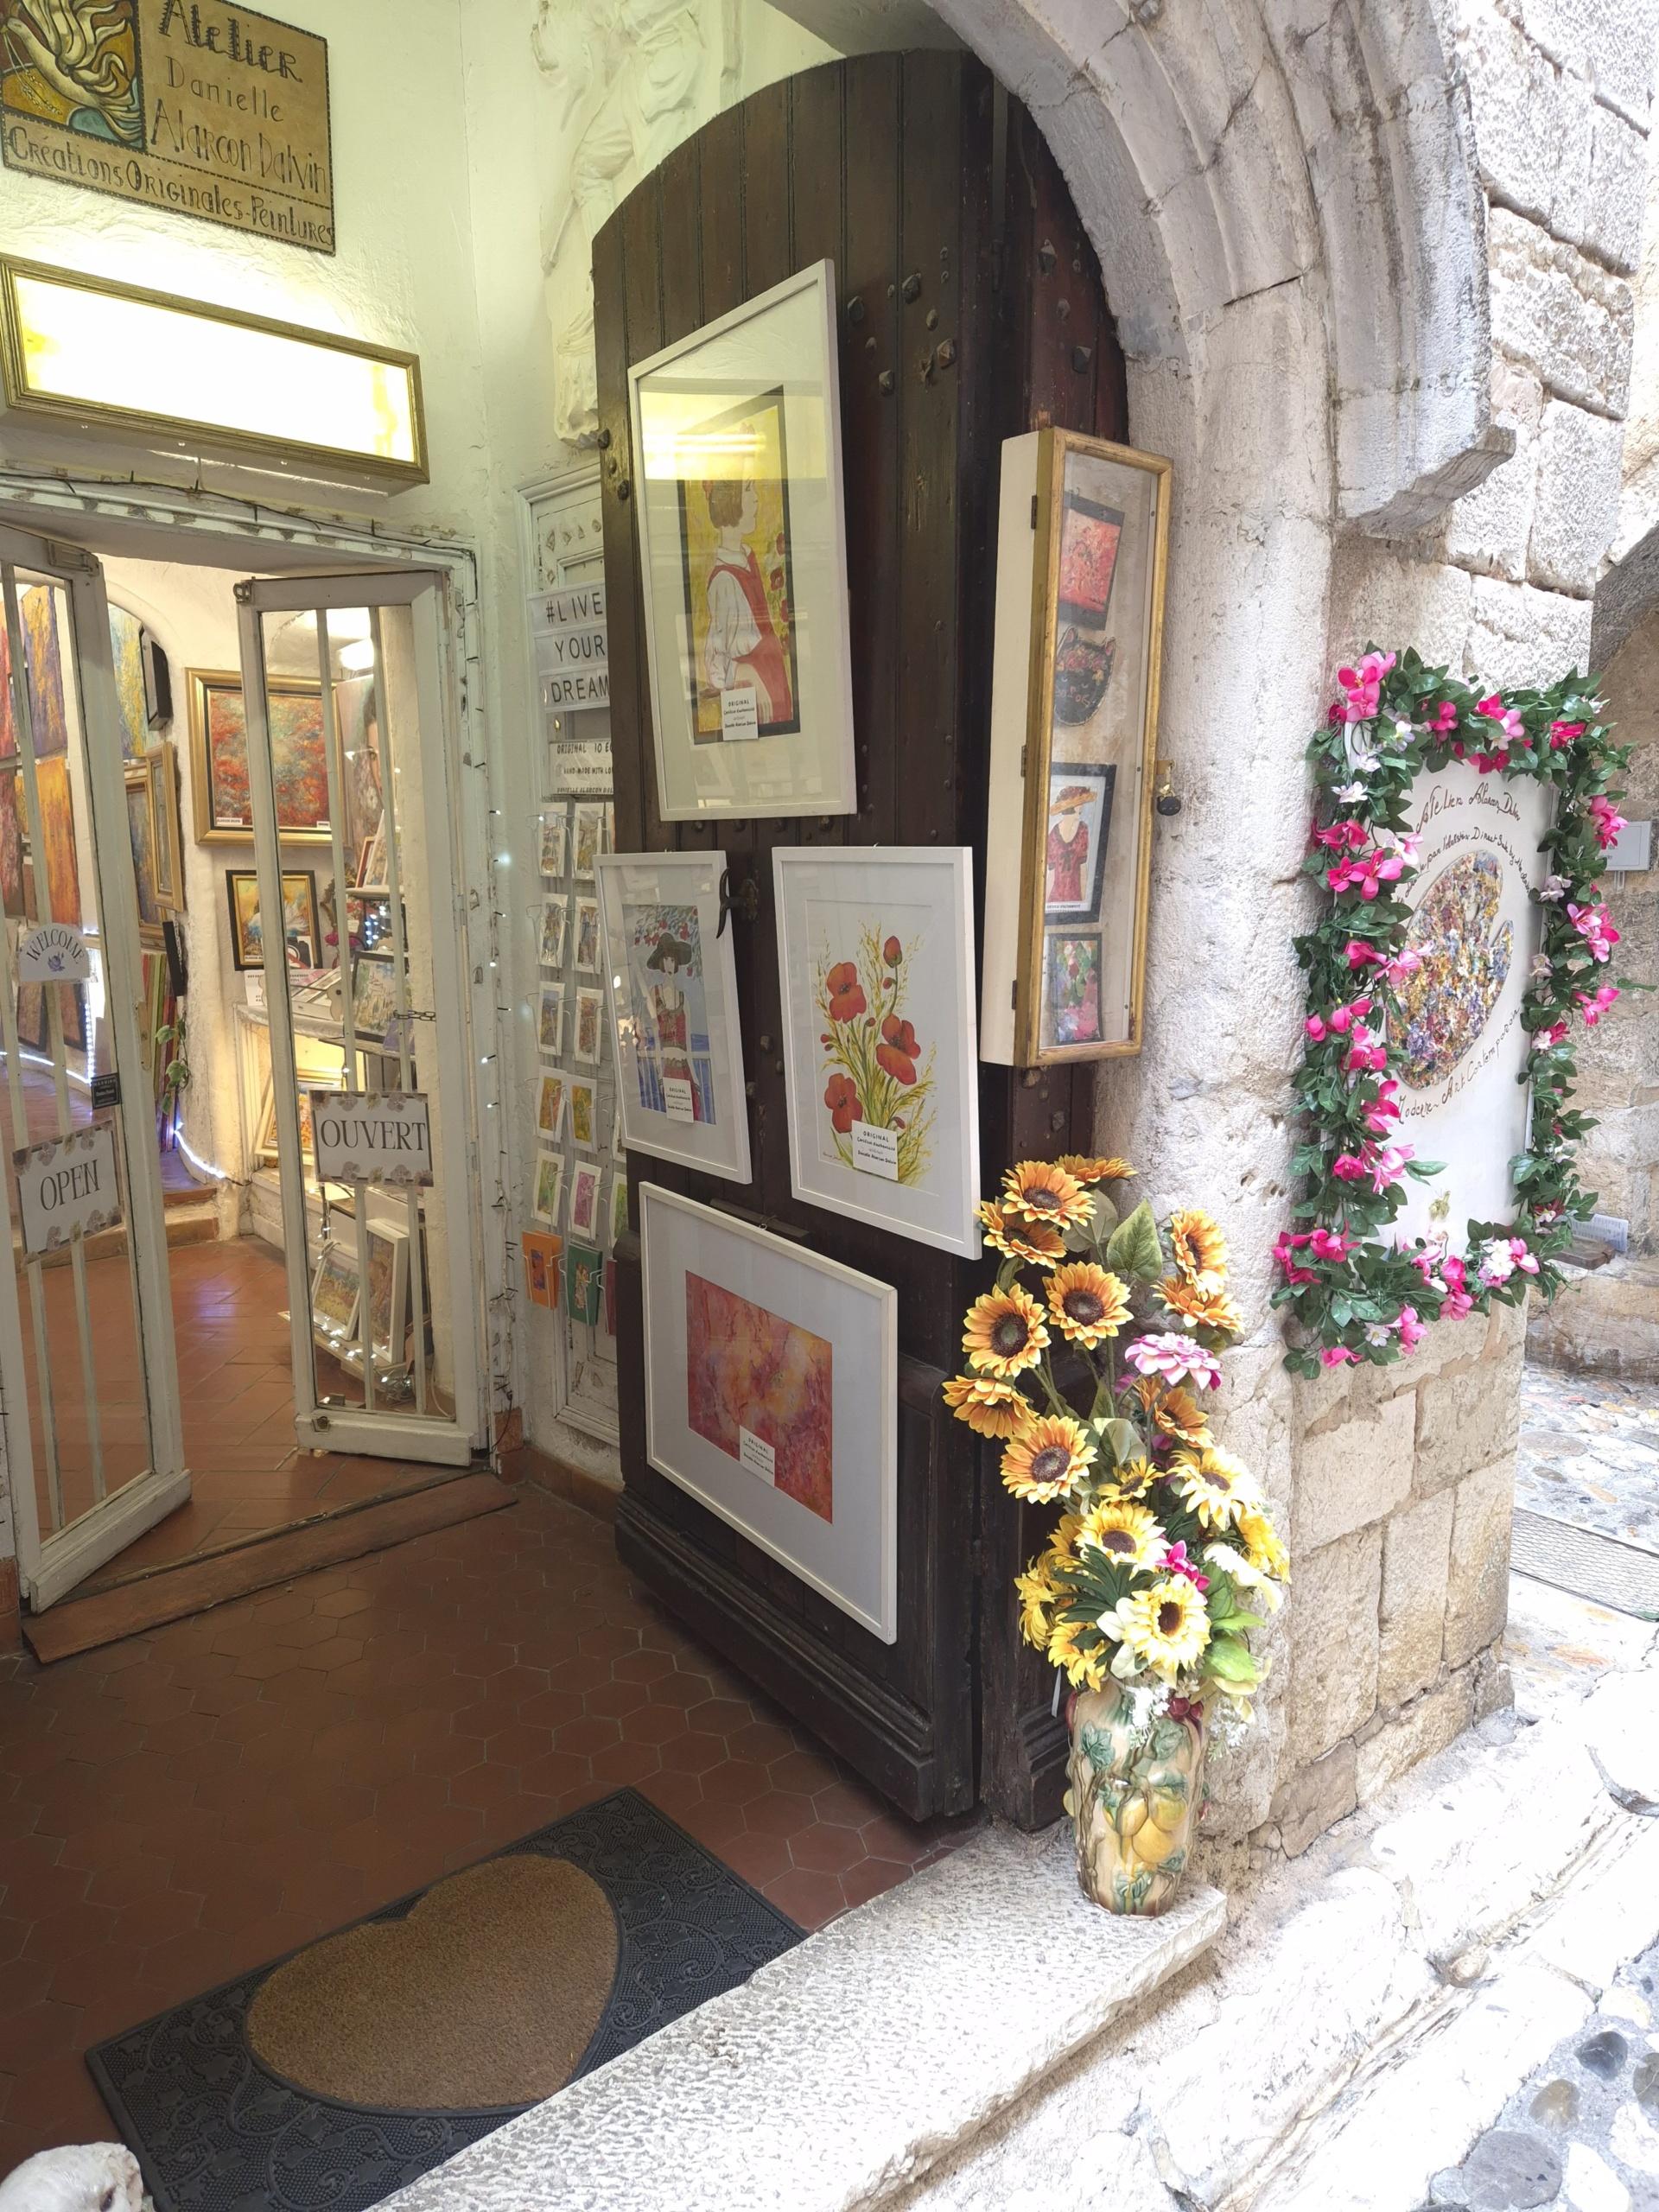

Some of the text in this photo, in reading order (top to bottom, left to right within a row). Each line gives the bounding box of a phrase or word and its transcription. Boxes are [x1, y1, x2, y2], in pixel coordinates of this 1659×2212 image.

[166, 55, 284, 122] Danielle
[545, 592, 603, 624] #LIVE
[554, 634, 606, 663] YOUR
[556, 743, 587, 754] ORIGINAL
[26, 928, 86, 963] WELCOME
[320, 1119, 426, 1151] OUVERT
[863, 1131, 888, 1142] ORIGINAL
[40, 1159, 100, 1211] OPEN
